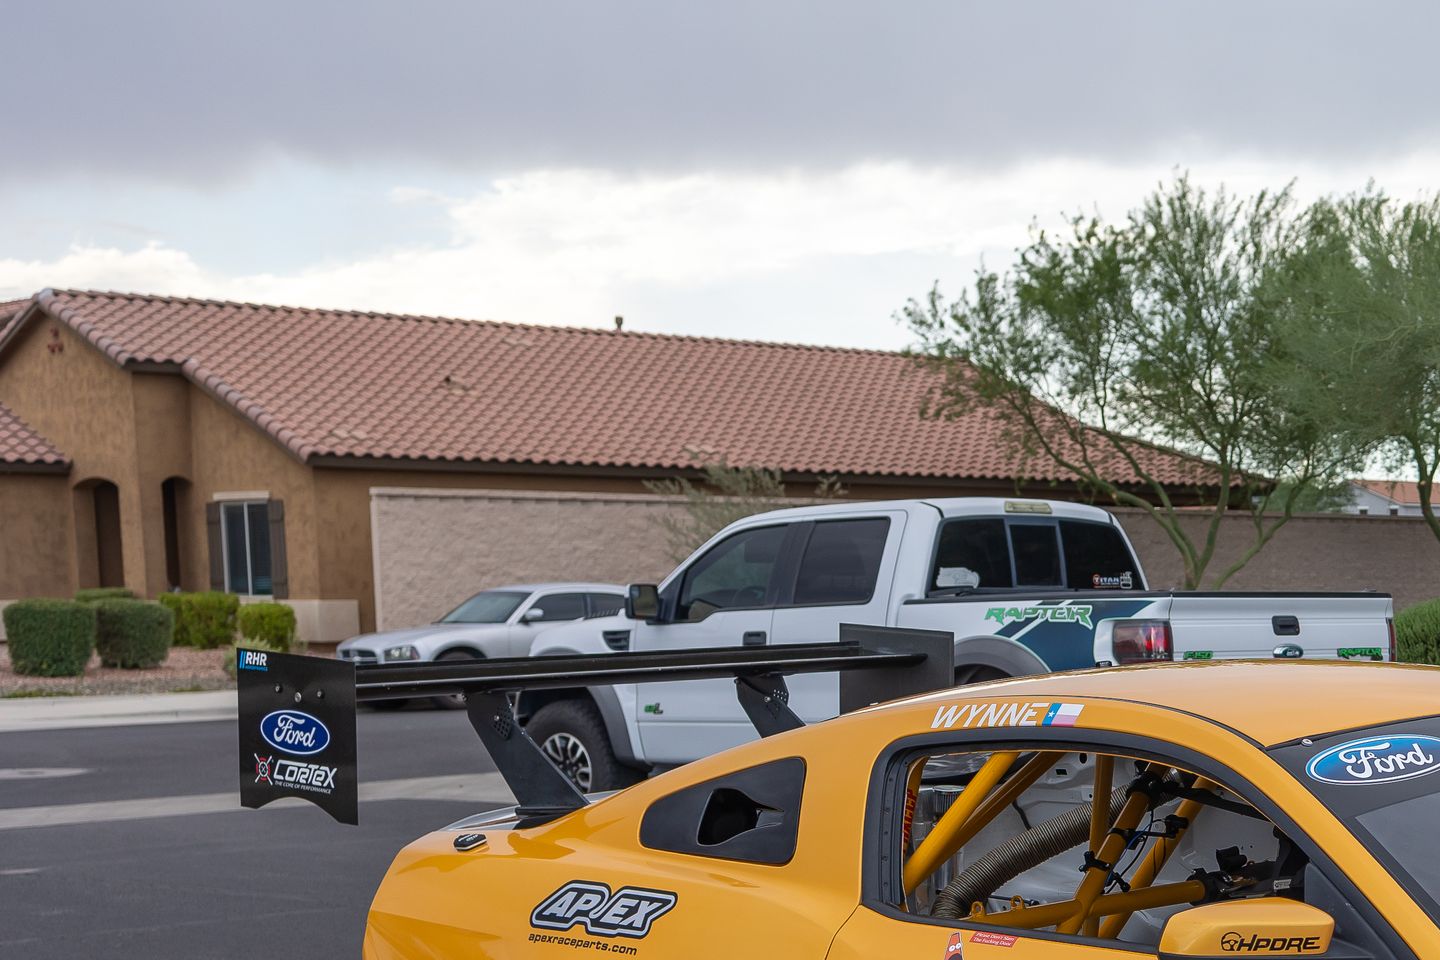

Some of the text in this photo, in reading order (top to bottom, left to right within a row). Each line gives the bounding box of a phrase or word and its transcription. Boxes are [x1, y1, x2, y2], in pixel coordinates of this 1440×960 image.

[985, 604, 1093, 630] RAPTOR
[245, 651, 267, 666] RHR
[930, 702, 1050, 729] WYNNE
[273, 714, 317, 748] Ford
[1338, 741, 1434, 779] Ford
[542, 890, 663, 929] APEX
[528, 932, 638, 956] apexraceparts.com
